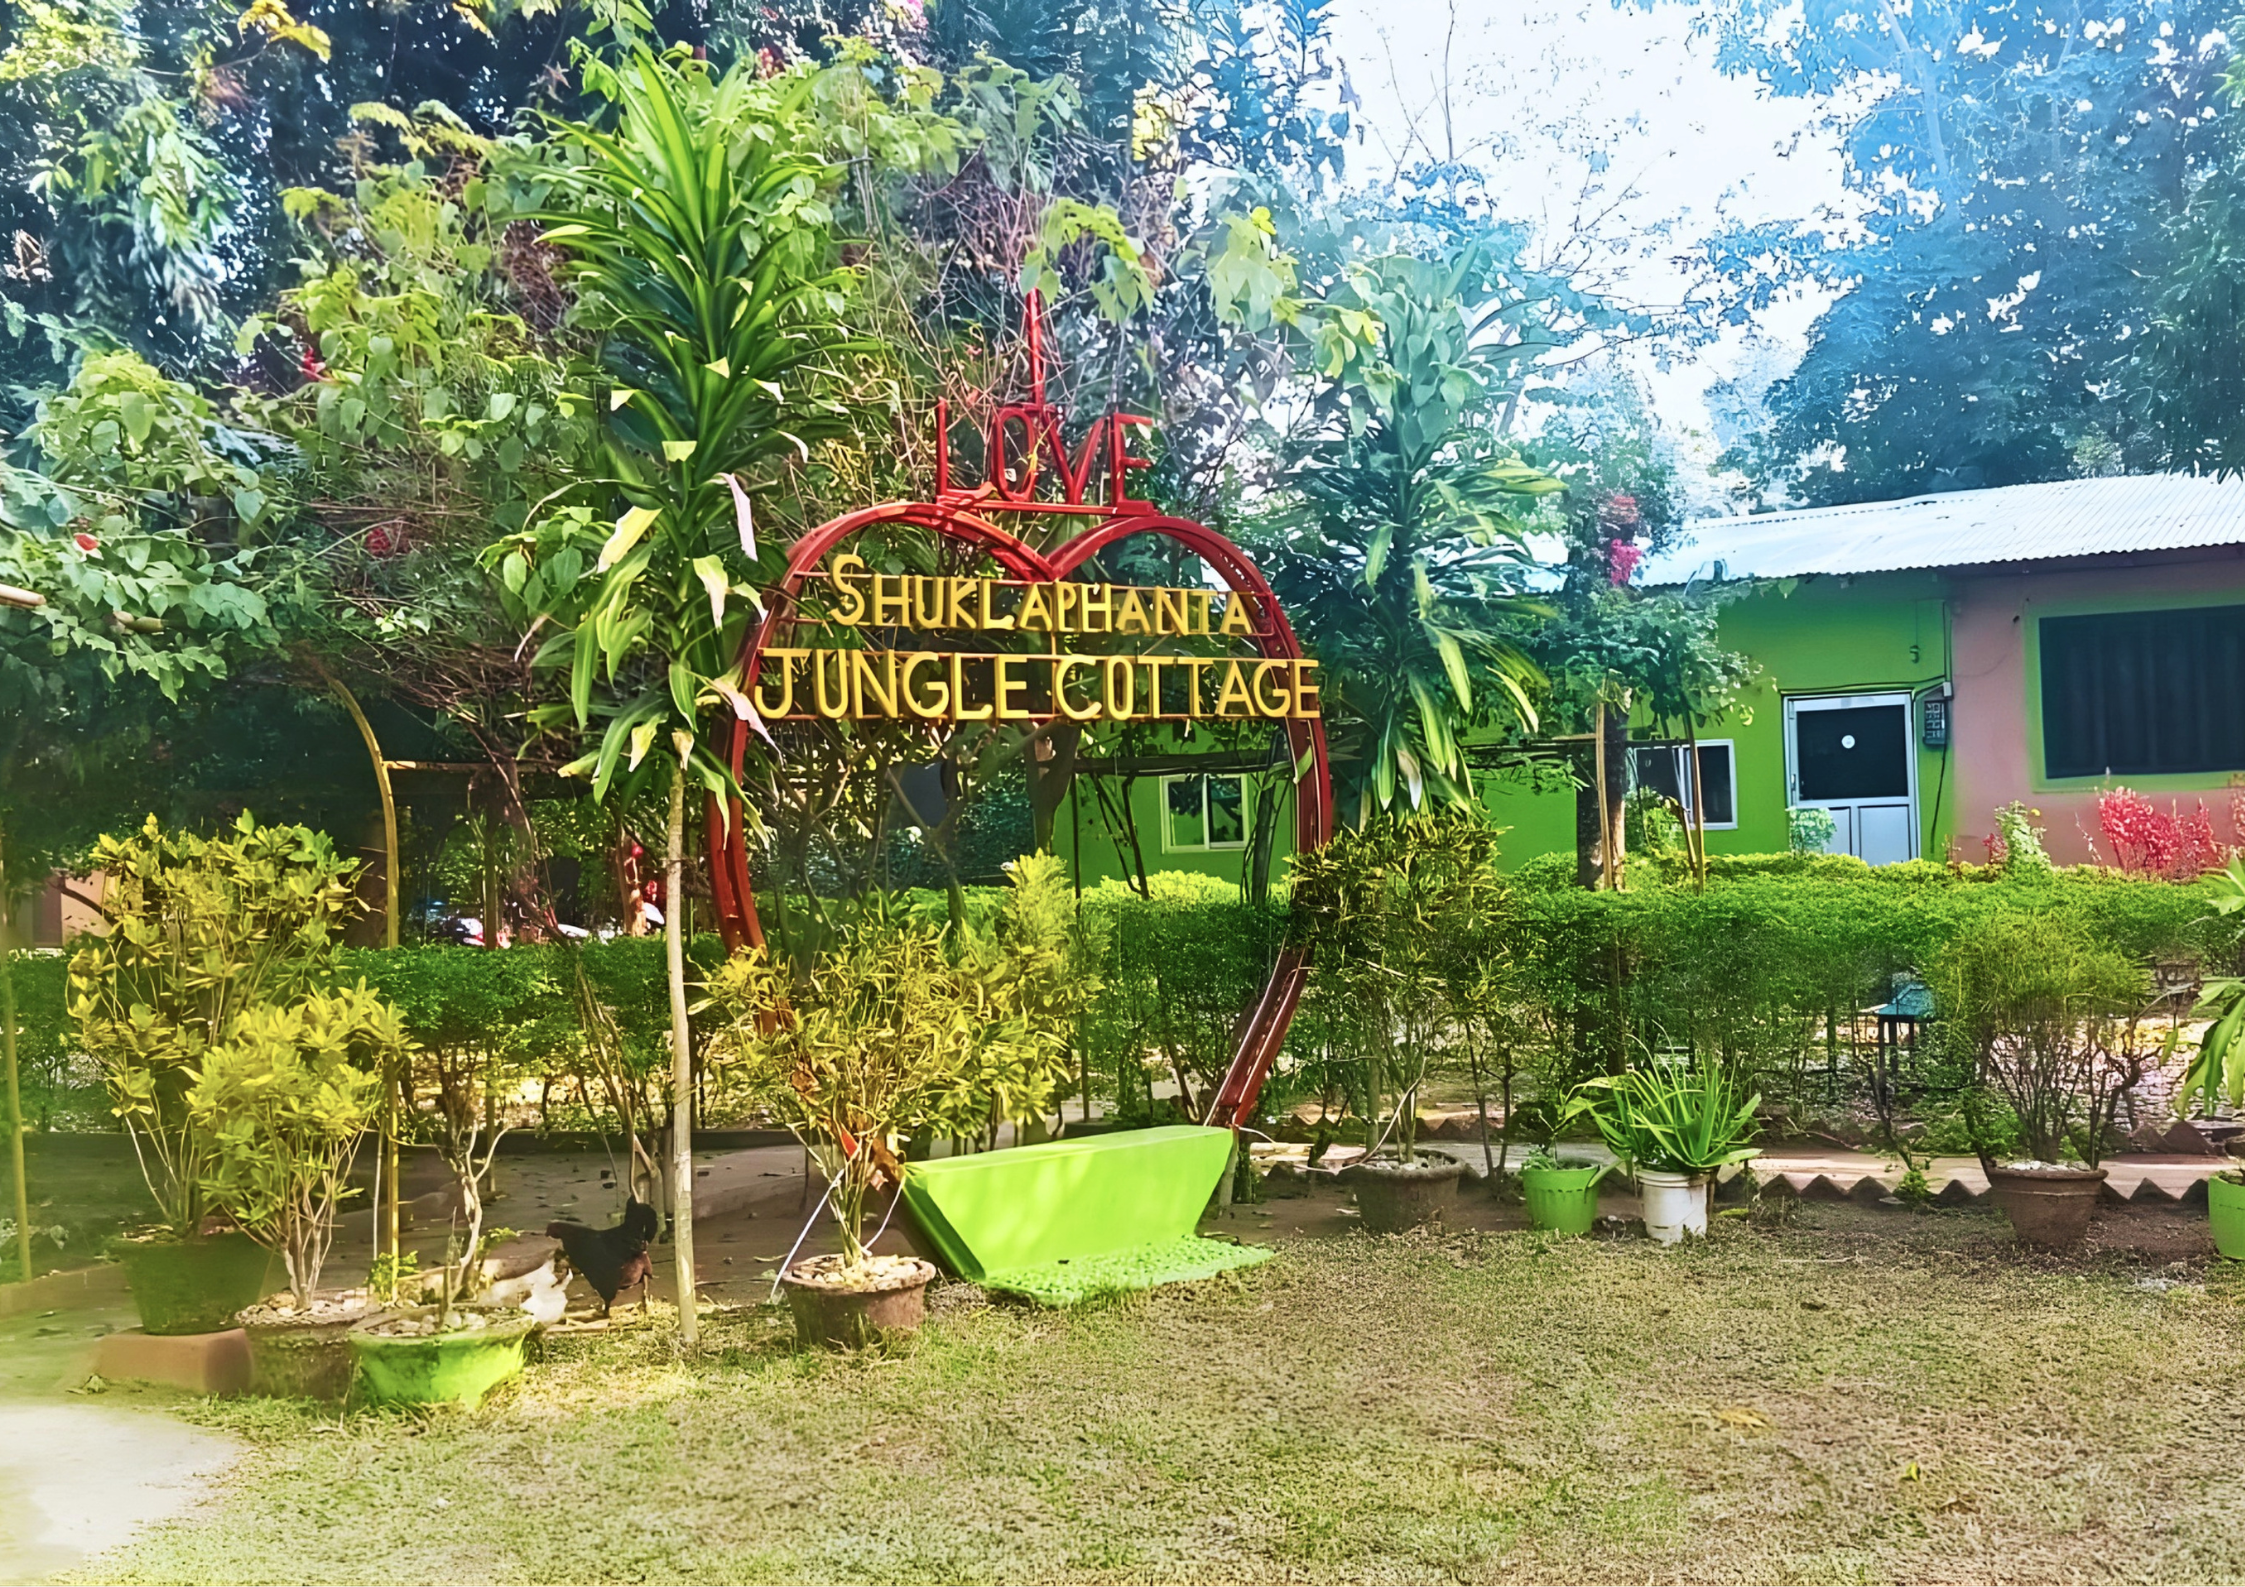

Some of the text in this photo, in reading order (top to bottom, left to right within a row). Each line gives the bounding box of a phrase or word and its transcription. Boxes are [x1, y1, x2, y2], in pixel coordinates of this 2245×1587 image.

[936, 396, 1155, 511] LOVE
[829, 554, 1253, 636] SHUKLAPHANTA
[754, 648, 1321, 721] JUNGLE COTTAGE
